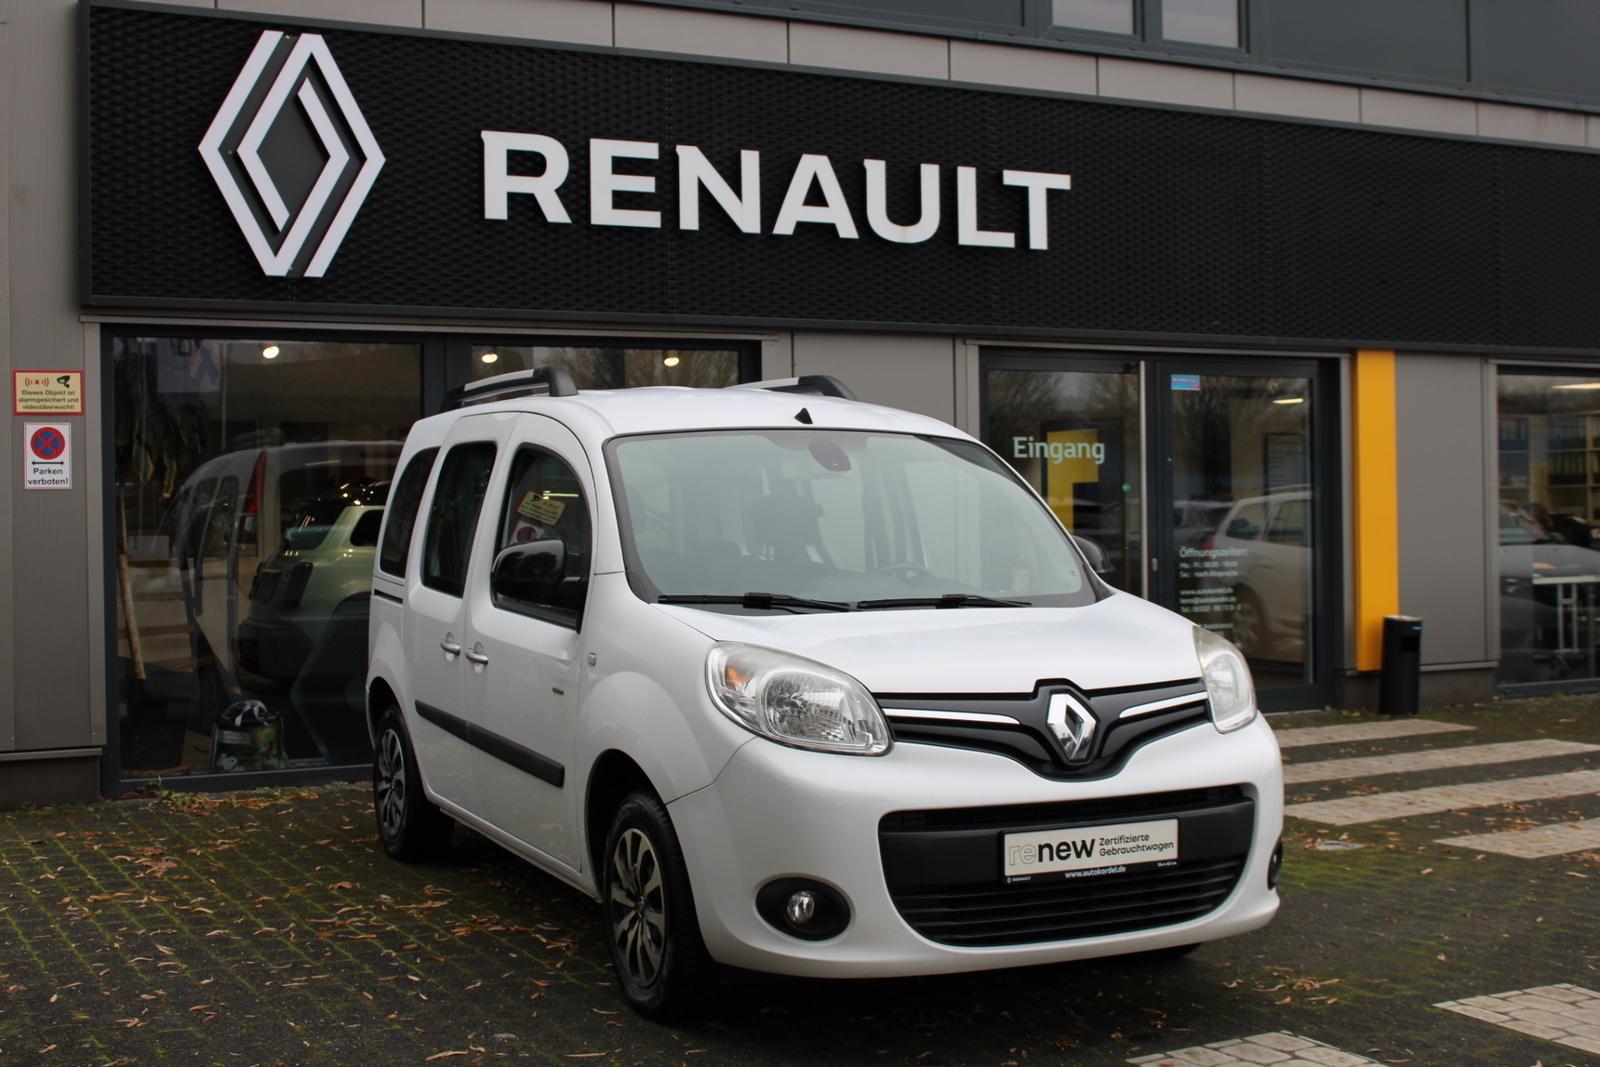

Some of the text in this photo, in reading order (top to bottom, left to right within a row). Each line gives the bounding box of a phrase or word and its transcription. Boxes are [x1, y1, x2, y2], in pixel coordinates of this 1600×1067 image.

[480, 130, 1072, 250] RENAULT
[1013, 437, 1105, 464] Eingang
[33, 467, 63, 475] Parken
[1100, 833, 1150, 847] Zertifizierte
[1100, 841, 1174, 857] Gebrauchtwagen
[1009, 839, 1095, 866] renew
